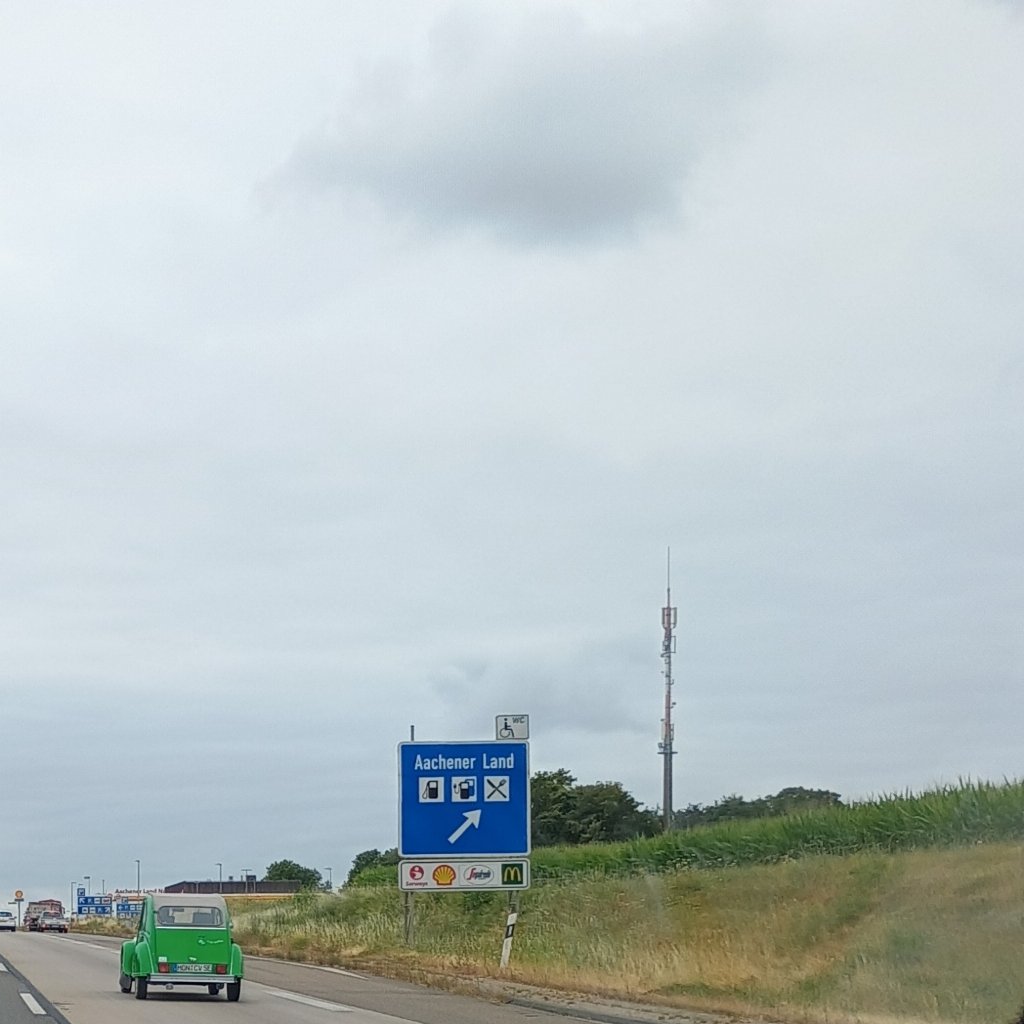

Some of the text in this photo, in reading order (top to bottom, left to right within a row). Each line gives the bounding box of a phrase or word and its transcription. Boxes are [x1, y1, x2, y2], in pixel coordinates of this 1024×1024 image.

[512, 716, 525, 724] WC
[414, 752, 514, 770] Aachener Land
